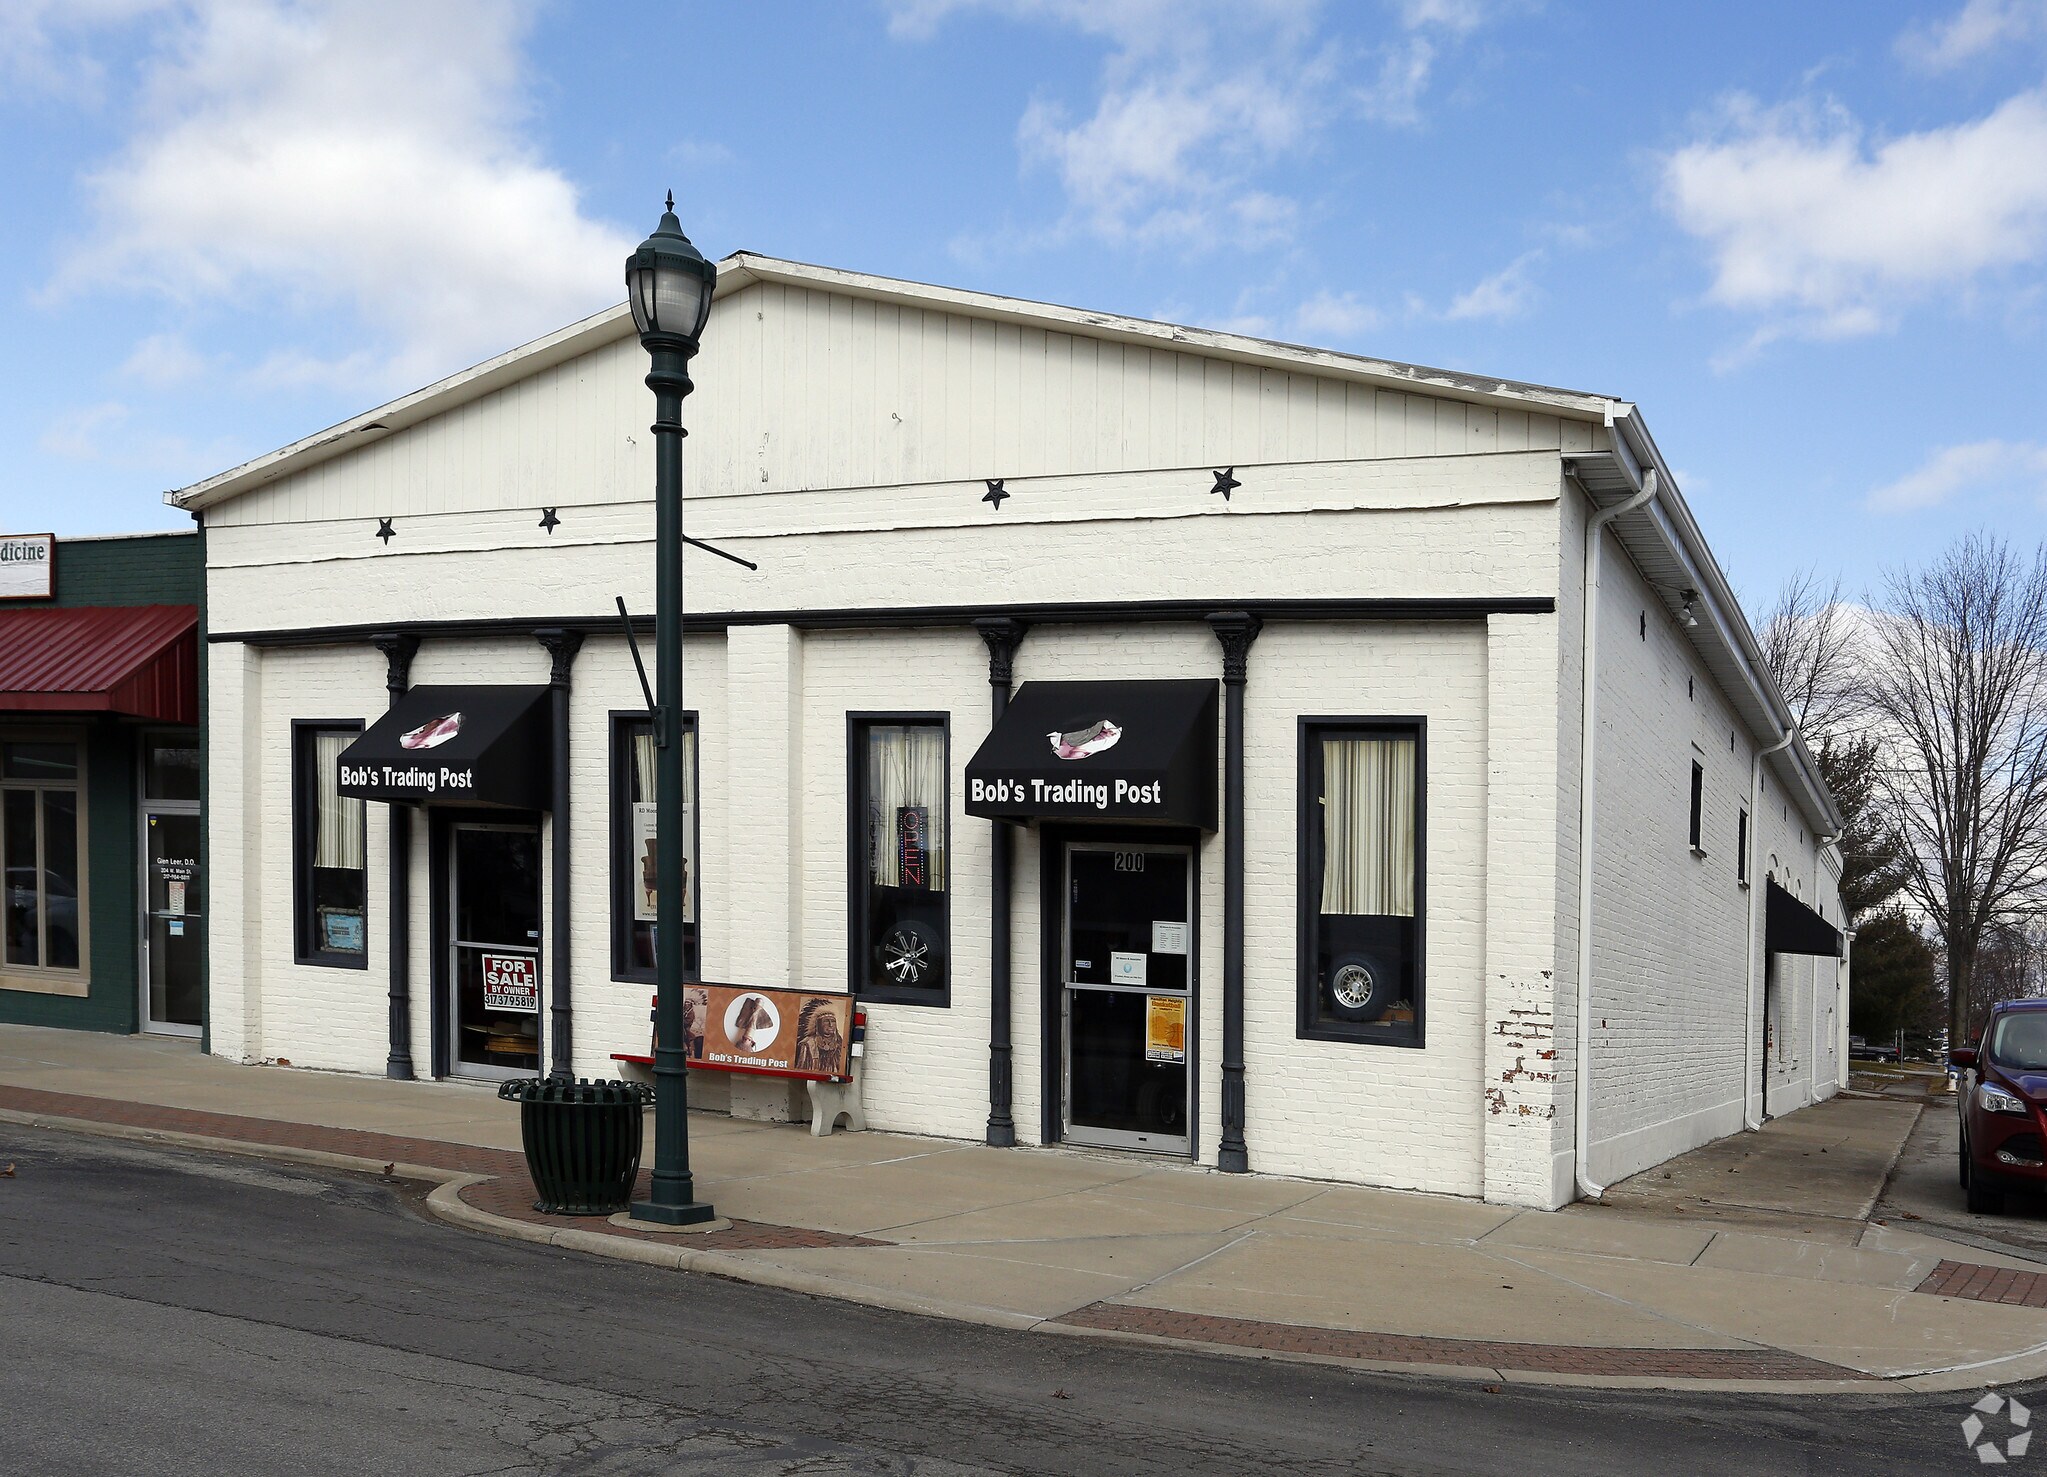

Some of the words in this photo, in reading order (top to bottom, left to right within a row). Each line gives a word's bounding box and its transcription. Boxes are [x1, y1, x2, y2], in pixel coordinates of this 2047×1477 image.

[341, 766, 379, 786] Bob's
[382, 766, 436, 792] Trading
[440, 767, 473, 788] Post
[971, 778, 1025, 802] Bob's
[1030, 779, 1108, 810] Trading
[1114, 779, 1161, 804] Post
[904, 811, 919, 884] OPEN
[1115, 852, 1143, 871] 200
[492, 960, 526, 973] FOR
[487, 971, 534, 987] SALE
[491, 985, 502, 994] BY
[503, 986, 531, 996] OWNER
[485, 994, 535, 1008] 3173795819
[709, 1052, 733, 1063] Bob's
[733, 1055, 767, 1067] Trading
[768, 1058, 788, 1068] Post
